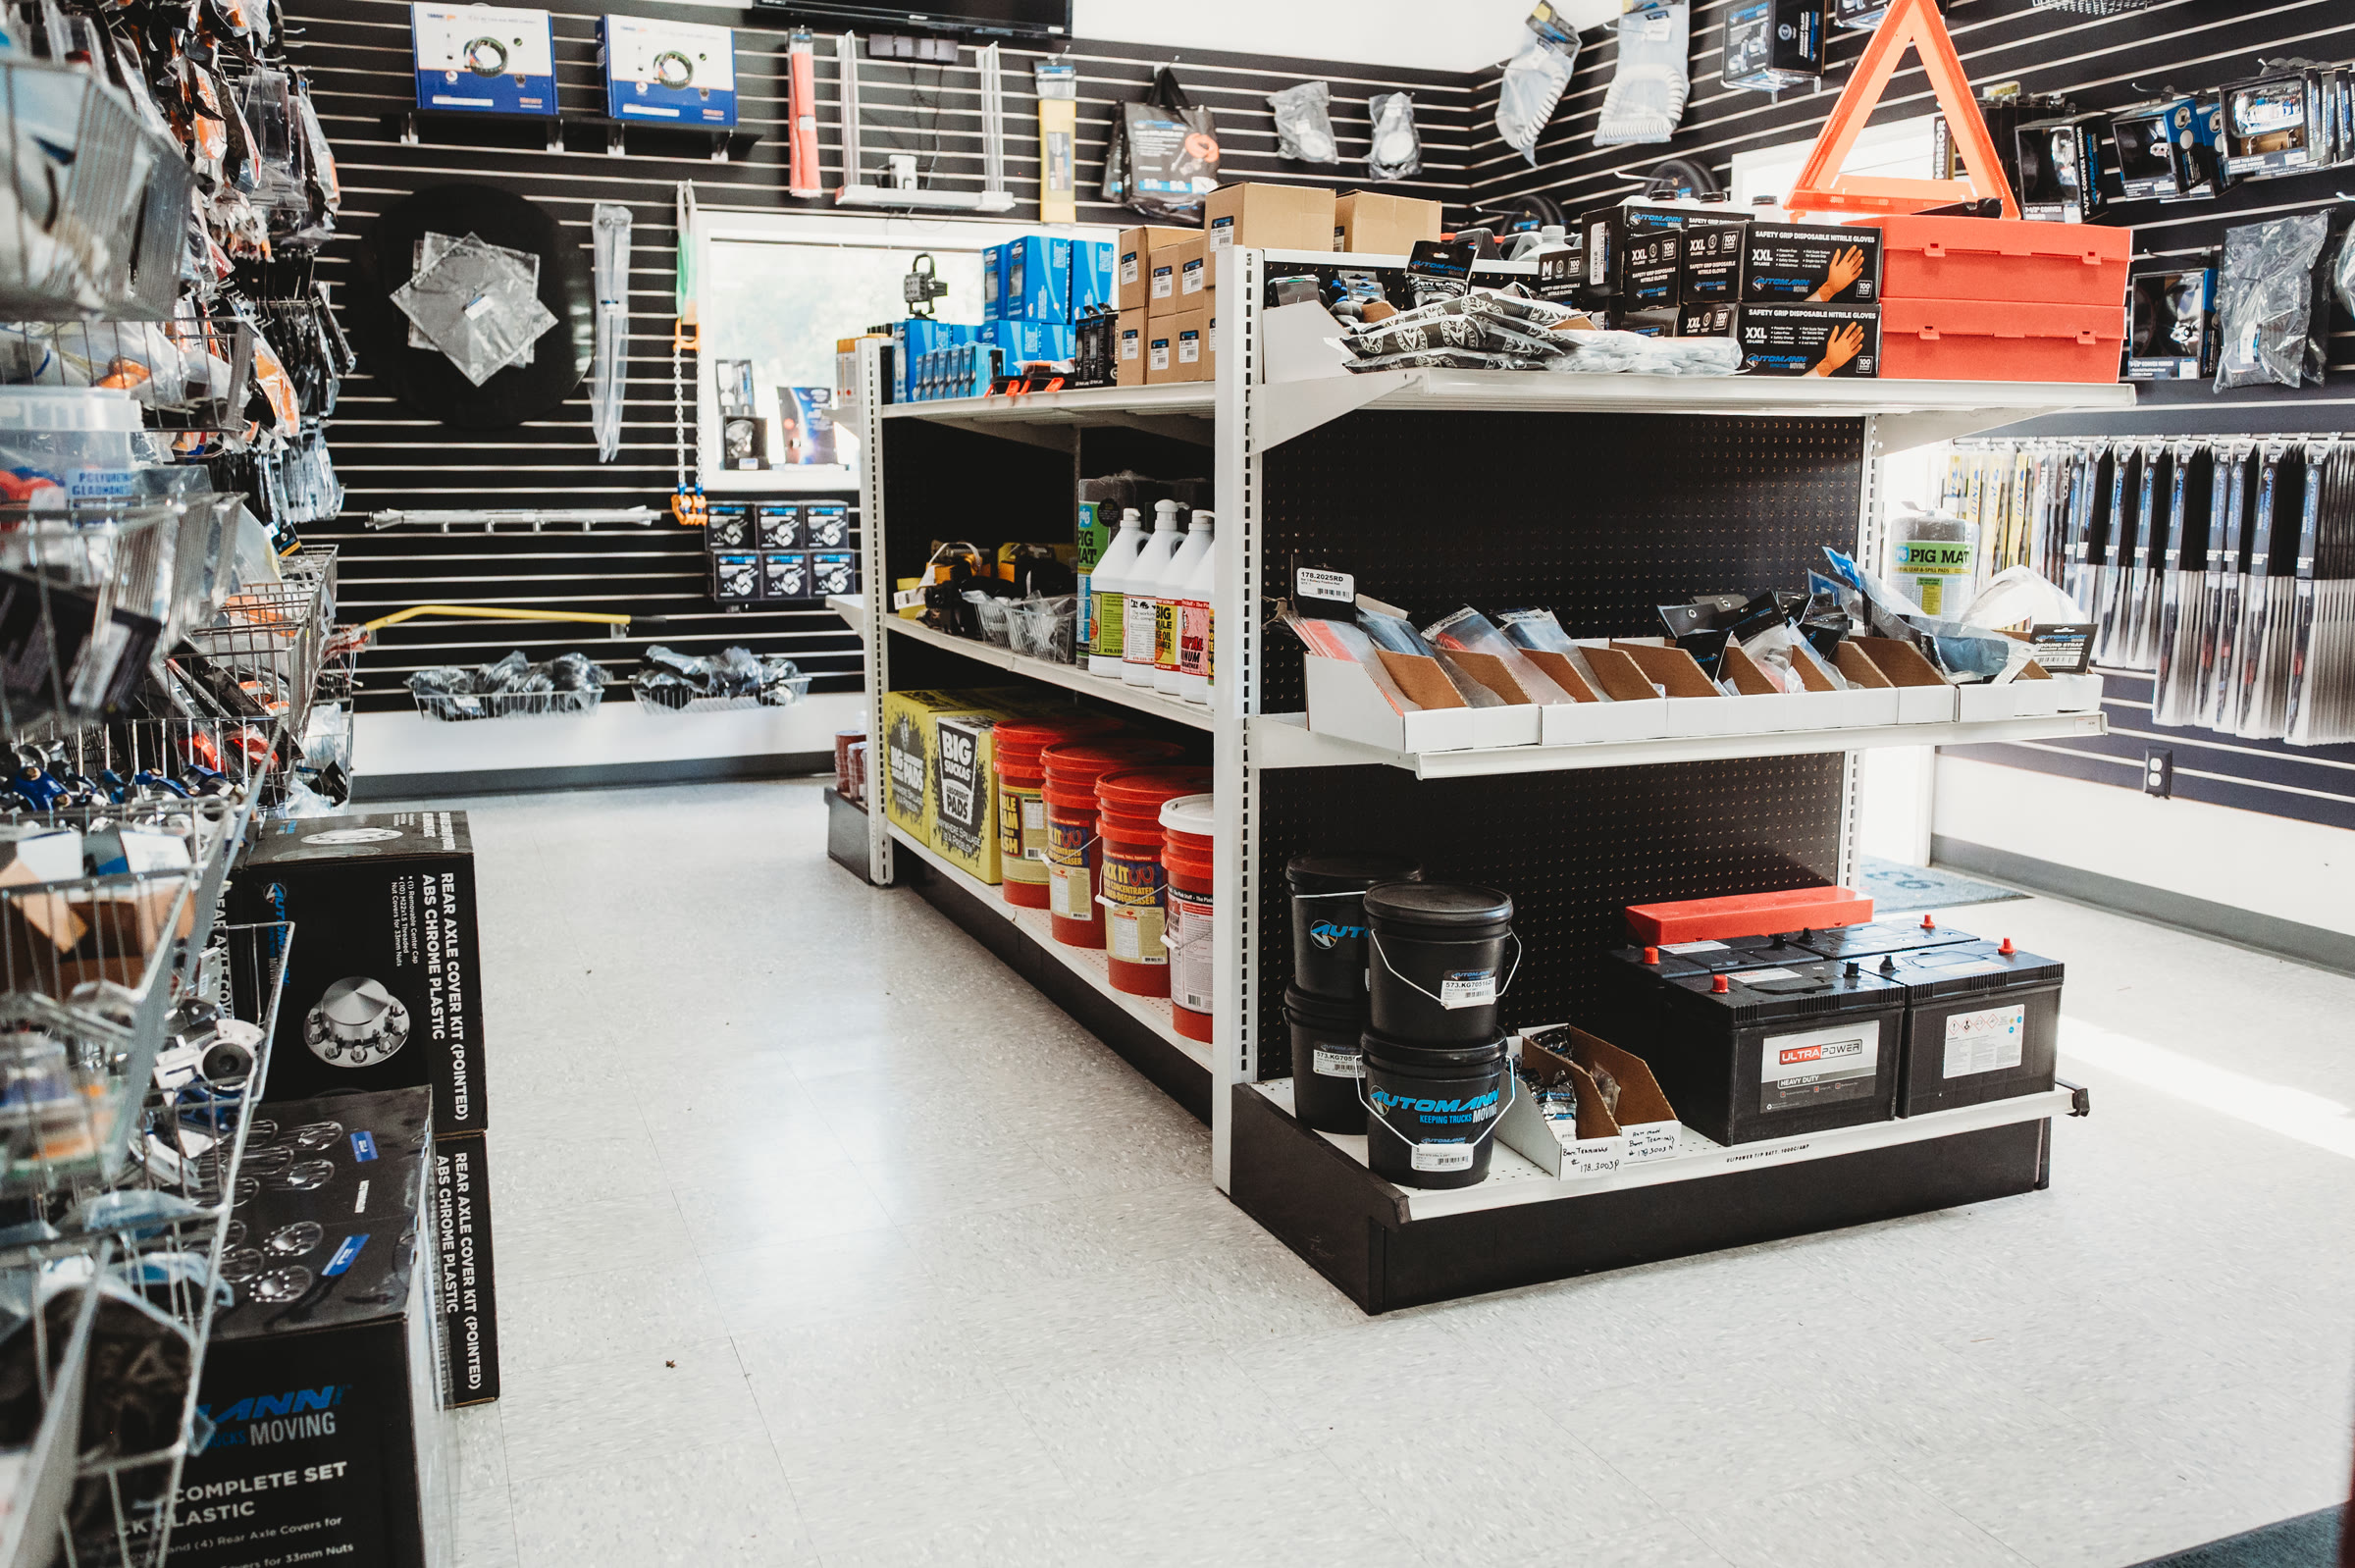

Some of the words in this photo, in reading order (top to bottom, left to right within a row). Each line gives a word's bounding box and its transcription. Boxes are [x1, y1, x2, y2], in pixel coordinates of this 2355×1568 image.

[1935, 120, 1946, 180] MIRROR
[2076, 127, 2085, 158] MIRROR
[2079, 158, 2088, 191] CONVEX
[2087, 133, 2098, 205] AUTOMANN
[1634, 214, 1683, 223] AUTOMANN
[1690, 239, 1705, 251] XXL
[1794, 233, 1830, 241] DISPOSABLE
[1410, 260, 1466, 272] AUTOMANN
[1542, 261, 1552, 277] M
[1632, 248, 1648, 261] XXL
[1752, 248, 1773, 262] XXL
[1687, 317, 1701, 329] XXL
[1745, 327, 1767, 340] XXL
[2263, 468, 2274, 533] AUTOMANN
[1910, 549, 1936, 563] PIG
[1941, 549, 1969, 563] MAT
[1301, 571, 1343, 582] 178.2025RD
[1156, 605, 1172, 620] BIG
[1163, 631, 1172, 642] OIL
[942, 729, 972, 765] BIG
[944, 759, 972, 781] SUCKAS
[946, 785, 968, 801] ABSORBENT
[947, 794, 968, 820] PADS
[960, 827, 981, 845] SPILLAGE
[422, 874, 437, 906] ABS
[441, 872, 456, 915] REAR
[408, 891, 417, 926] Removable
[424, 909, 442, 974] CHROME
[445, 917, 459, 959] AXLE
[446, 961, 462, 1013] COVER
[429, 977, 445, 1040] PLASTIC
[450, 1016, 464, 1040] KIT
[450, 1043, 469, 1121] (POINTED)
[1780, 1076, 1801, 1086] HEAVY
[1803, 1075, 1819, 1084] DUTY
[1371, 1088, 1499, 1113] AUTOMANN
[1419, 1115, 1447, 1124] KEEPING
[1449, 1113, 1472, 1124] TRUCKS
[1473, 1103, 1497, 1124] MOVING
[437, 1155, 450, 1185] ABS
[454, 1152, 469, 1193] REAR
[439, 1188, 455, 1251] CHROME
[458, 1196, 472, 1234] AXLE
[460, 1236, 476, 1286] COVER
[444, 1253, 459, 1314] PLASTIC
[464, 1289, 477, 1313] KIT
[464, 1316, 482, 1389] (POINTED)
[249, 1411, 337, 1447] MOVING
[174, 1469, 297, 1504] COMPLETE
[303, 1460, 347, 1483] SET
[194, 1537, 214, 1551] (4)
[217, 1533, 245, 1545] Rear
[249, 1527, 278, 1542] Axle
[280, 1520, 322, 1537] Covers
[325, 1516, 341, 1528] for
[285, 1548, 324, 1564] 33mm
[326, 1542, 354, 1556] Nuts
